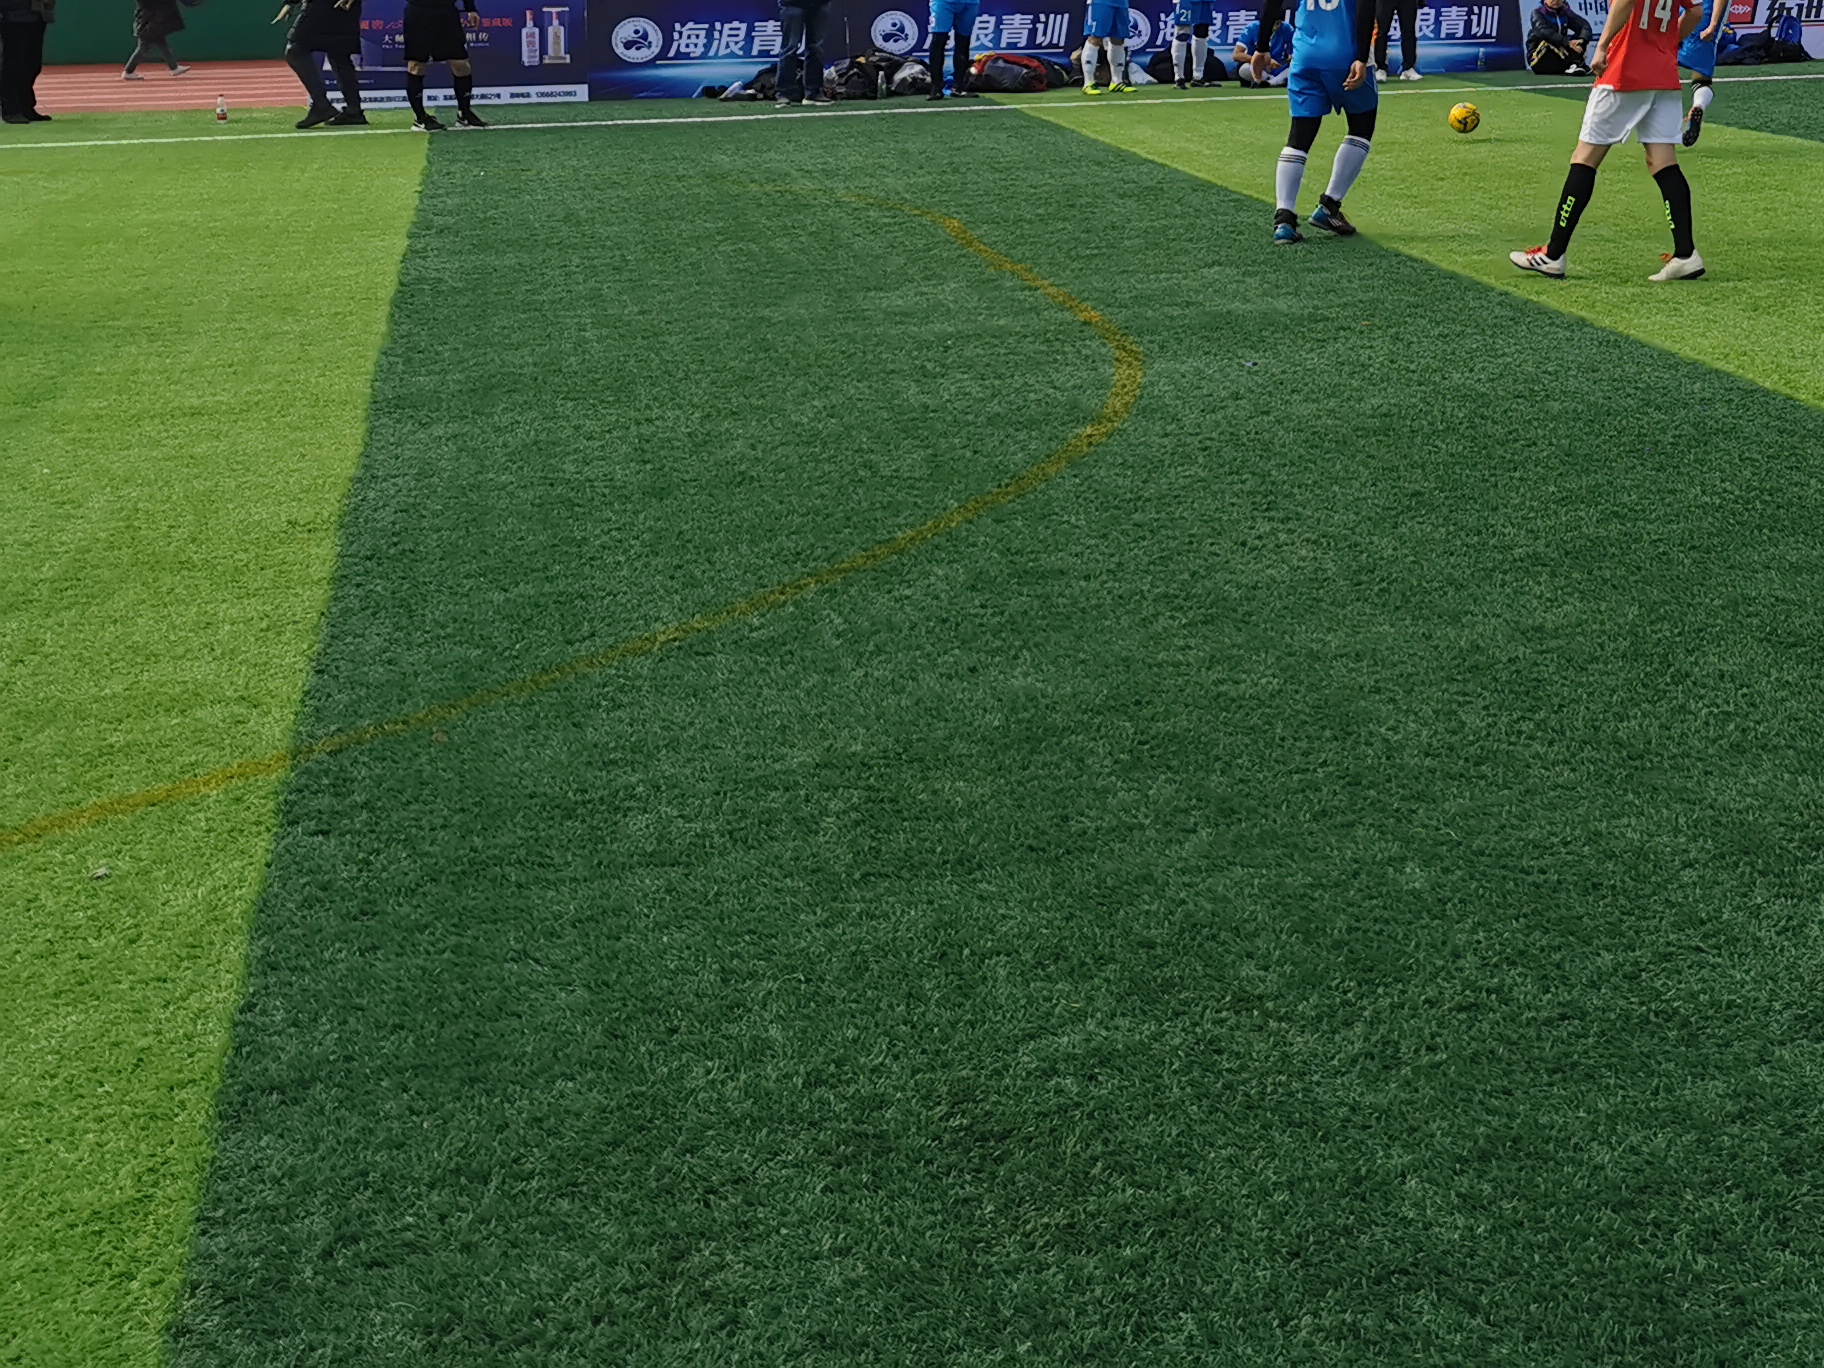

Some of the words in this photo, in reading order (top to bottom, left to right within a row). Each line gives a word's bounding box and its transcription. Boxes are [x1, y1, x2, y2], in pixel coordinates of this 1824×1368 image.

[922, 12, 1070, 50] 浪青训
[1179, 8, 1192, 22] 21
[1387, 5, 1499, 38] 浪青训
[667, 19, 806, 58] 海浪青
